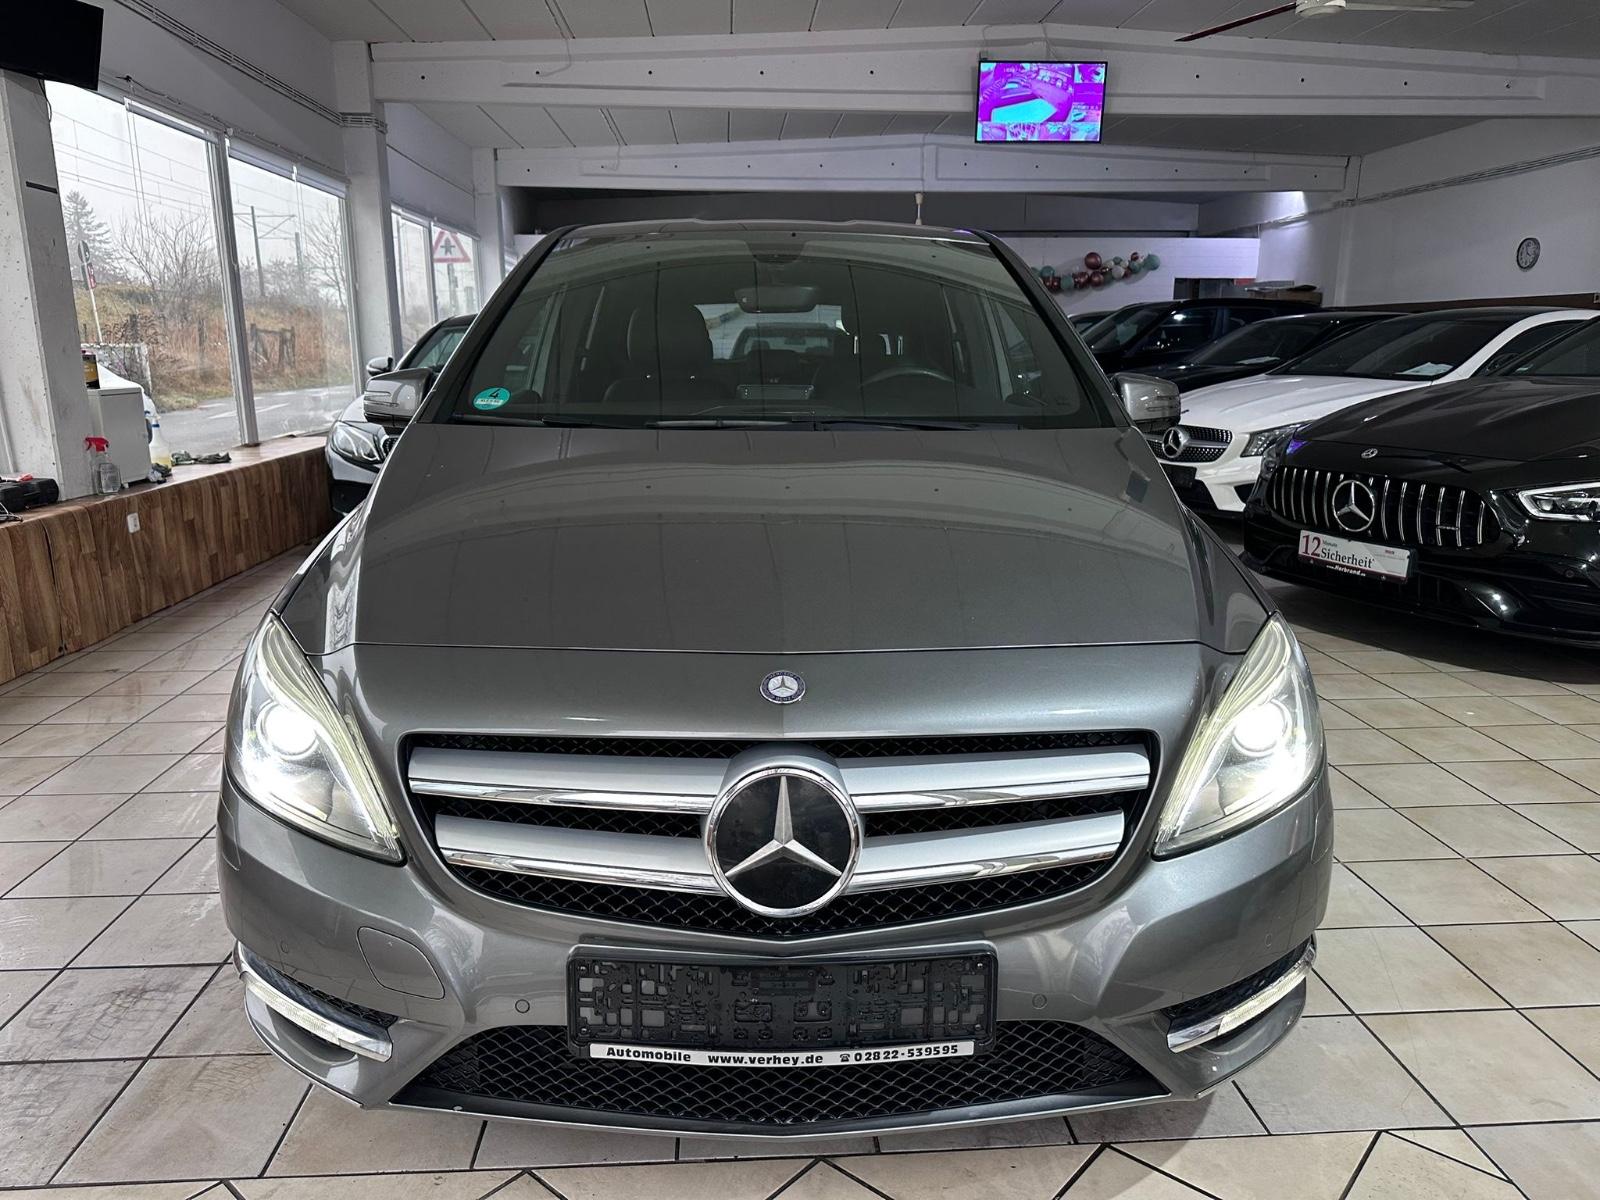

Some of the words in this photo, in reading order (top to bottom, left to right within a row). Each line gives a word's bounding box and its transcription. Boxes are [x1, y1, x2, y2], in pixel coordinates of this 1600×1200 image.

[488, 388, 500, 398] 4
[1302, 534, 1321, 557] 12
[606, 1047, 691, 1062] Automobile
[708, 1054, 823, 1065] www.verhey.de
